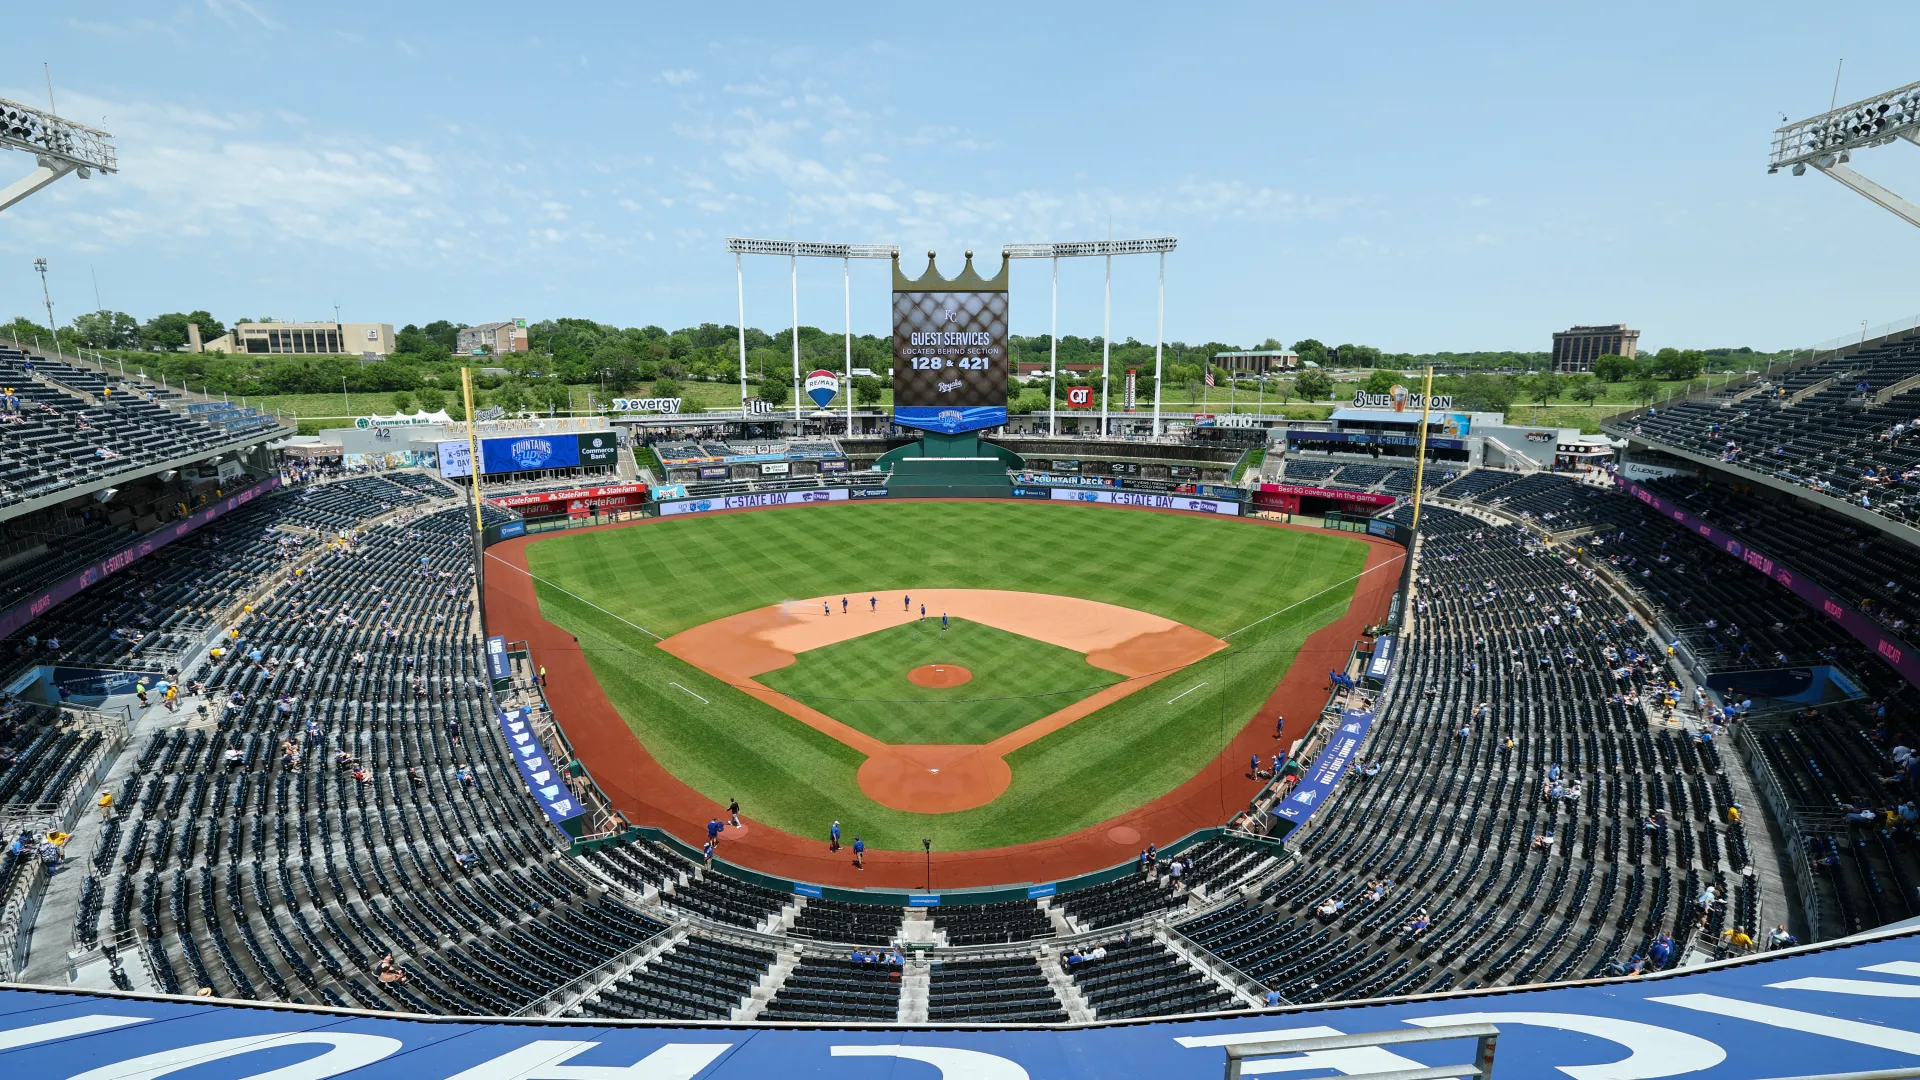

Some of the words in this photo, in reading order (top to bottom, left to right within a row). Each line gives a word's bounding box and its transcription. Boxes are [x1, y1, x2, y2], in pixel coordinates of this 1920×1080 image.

[944, 309, 957, 322] KC
[911, 332, 942, 345] GUEST
[944, 332, 990, 345] SERVICES
[911, 357, 942, 369] 128
[958, 357, 989, 369] 421
[938, 379, 962, 392] Royals
[1070, 389, 1089, 404] QT
[1353, 391, 1390, 407] BLUE
[630, 399, 680, 413] evergy
[750, 400, 772, 415] Lite
[1216, 415, 1252, 427] PATIO
[375, 428, 391, 438] 42
[445, 423, 484, 434] HAL
[1377, 436, 1406, 445] K-STATE
[512, 440, 552, 456] FOUNTAINS
[581, 447, 614, 455] Commerce
[457, 459, 471, 467] DAY
[1637, 468, 1664, 476] LEXUS
[1034, 475, 1078, 485] FOUNTAIN
[1111, 492, 1152, 506] K-STATE
[1155, 497, 1174, 508] DAY
[1304, 489, 1335, 499] coverage
[724, 494, 767, 509] K-STATE
[770, 493, 788, 504] DAY
[101, 554, 125, 576] K-STATE
[124, 548, 134, 567] DAY
[1743, 548, 1764, 566] K-STATE
[1763, 558, 1774, 576] DAY
[30, 594, 50, 616] WILDCATS
[1823, 600, 1843, 619] WILDCATS
[1878, 638, 1902, 664] WILDCATS
